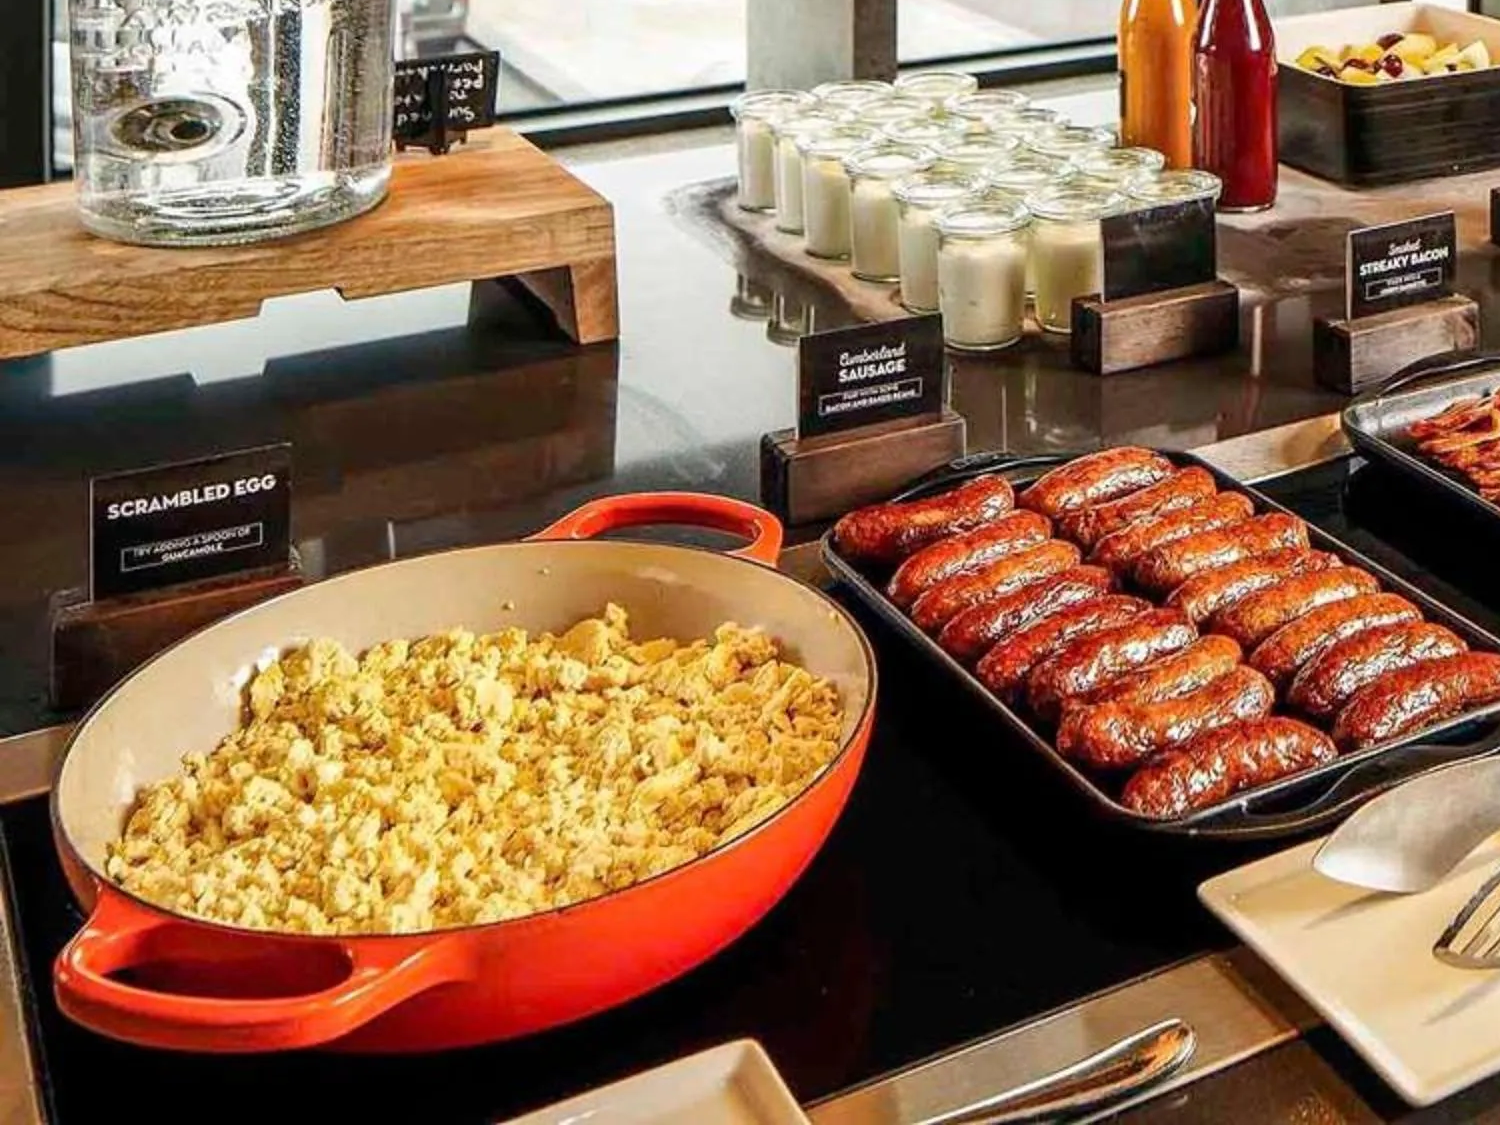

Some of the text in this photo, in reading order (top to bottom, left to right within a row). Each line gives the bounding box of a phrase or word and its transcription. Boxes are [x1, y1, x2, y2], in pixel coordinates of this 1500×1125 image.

[1359, 246, 1449, 276] STREAKY BACON
[839, 342, 906, 367] Cumberland
[838, 358, 906, 383] SAUSAGE
[107, 473, 277, 520] SCRAMBLED EGG
